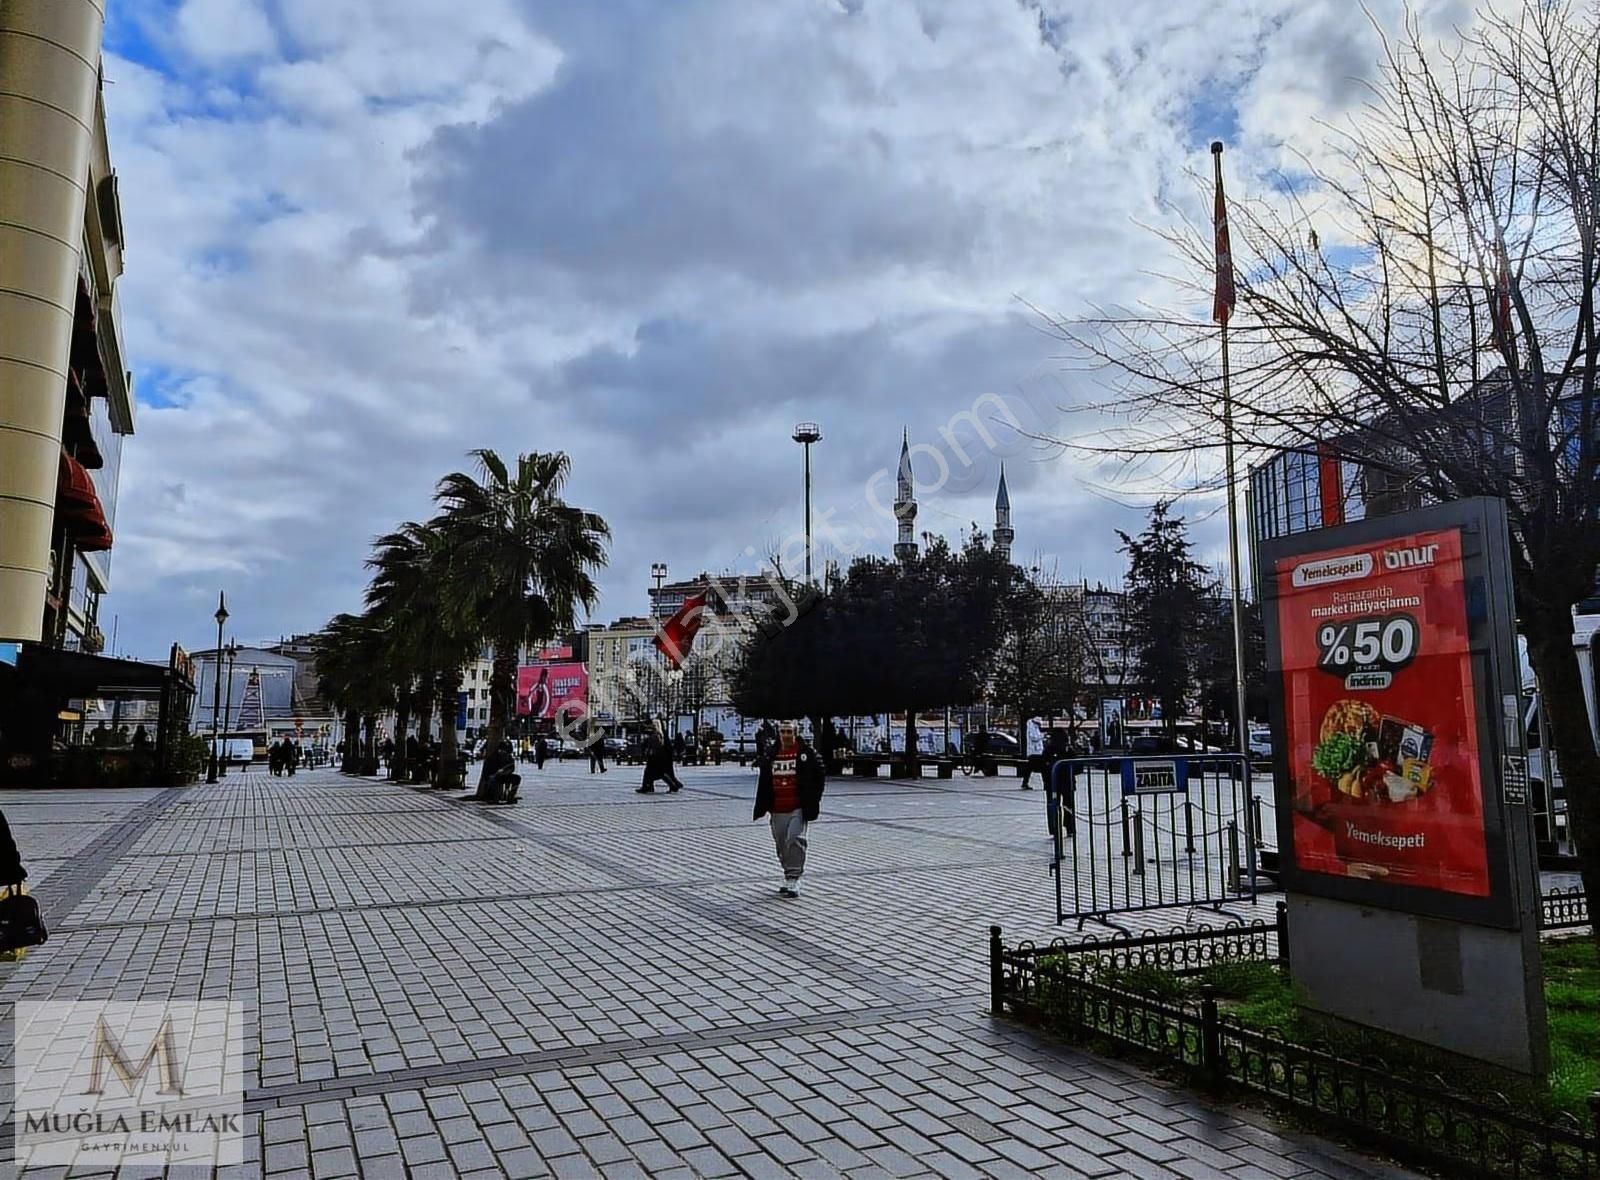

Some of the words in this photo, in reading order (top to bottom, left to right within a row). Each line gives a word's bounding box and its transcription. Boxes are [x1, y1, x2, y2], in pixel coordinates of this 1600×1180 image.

[1301, 560, 1363, 582] Yemeksepeti
[1311, 602, 1348, 617] market
[1320, 619, 1413, 665] %50
[1344, 820, 1425, 851] Yemeksepeti
